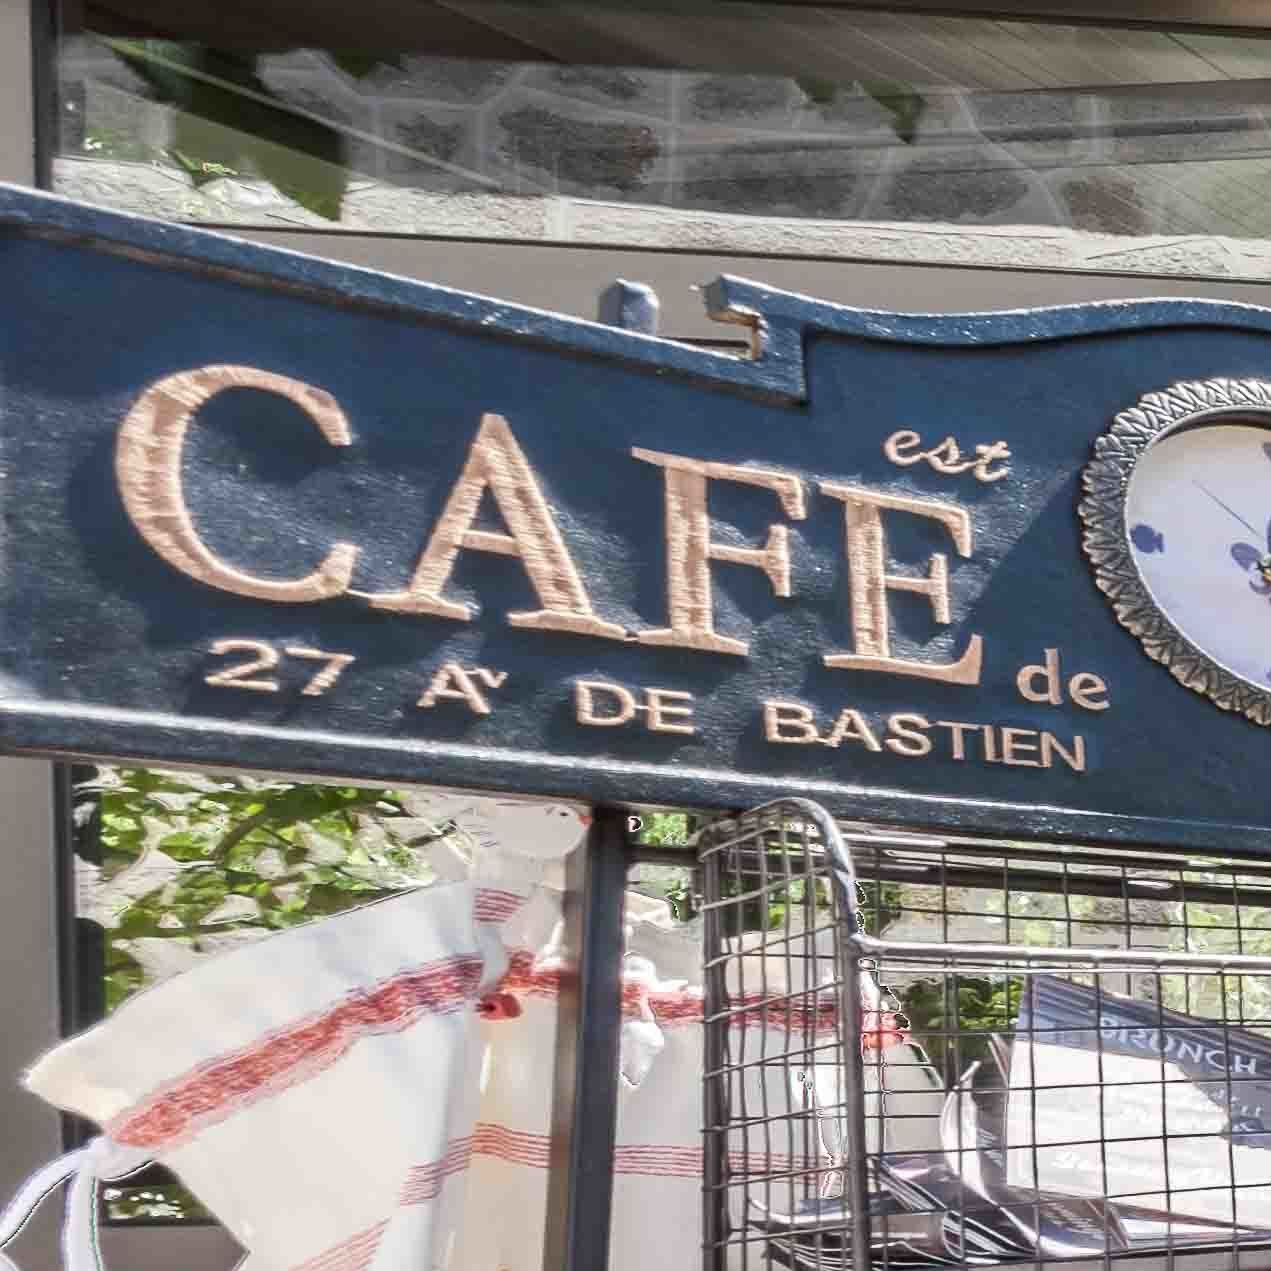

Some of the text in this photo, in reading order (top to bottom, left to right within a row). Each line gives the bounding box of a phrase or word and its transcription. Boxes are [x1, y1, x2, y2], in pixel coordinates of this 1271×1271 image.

[885, 430, 1011, 481] est
[115, 364, 983, 685] CAFE
[1017, 648, 1110, 710] de
[205, 639, 355, 698] 27
[574, 680, 694, 735] DE
[764, 701, 1086, 772] BASTIEN
